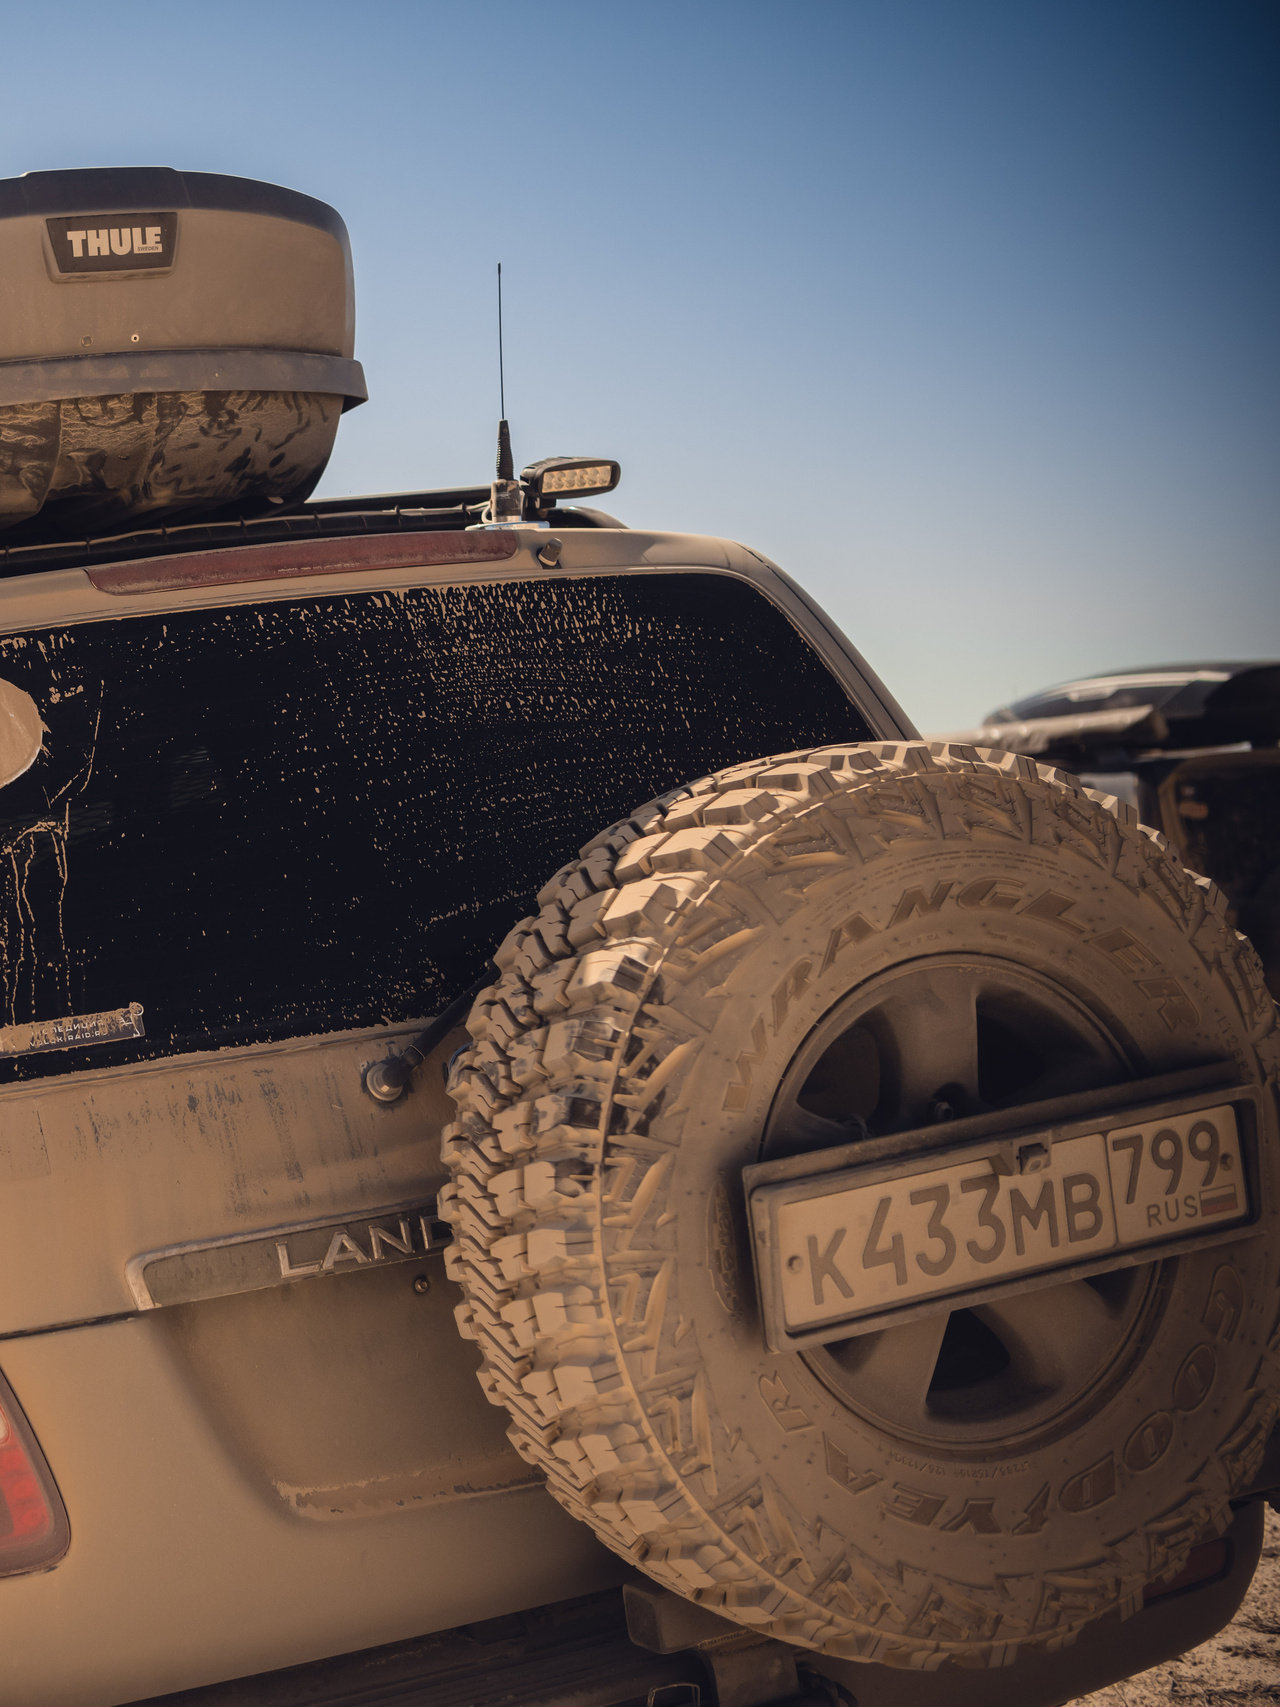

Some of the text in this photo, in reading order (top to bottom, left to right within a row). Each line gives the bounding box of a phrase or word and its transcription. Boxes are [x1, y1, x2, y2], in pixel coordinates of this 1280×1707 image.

[67, 227, 163, 258] THULE
[722, 877, 1201, 1113] WRANGLER
[1112, 1120, 1221, 1205] 799
[1146, 1196, 1199, 1228] RUS
[757, 1264, 1244, 1536] GOODYEAR
